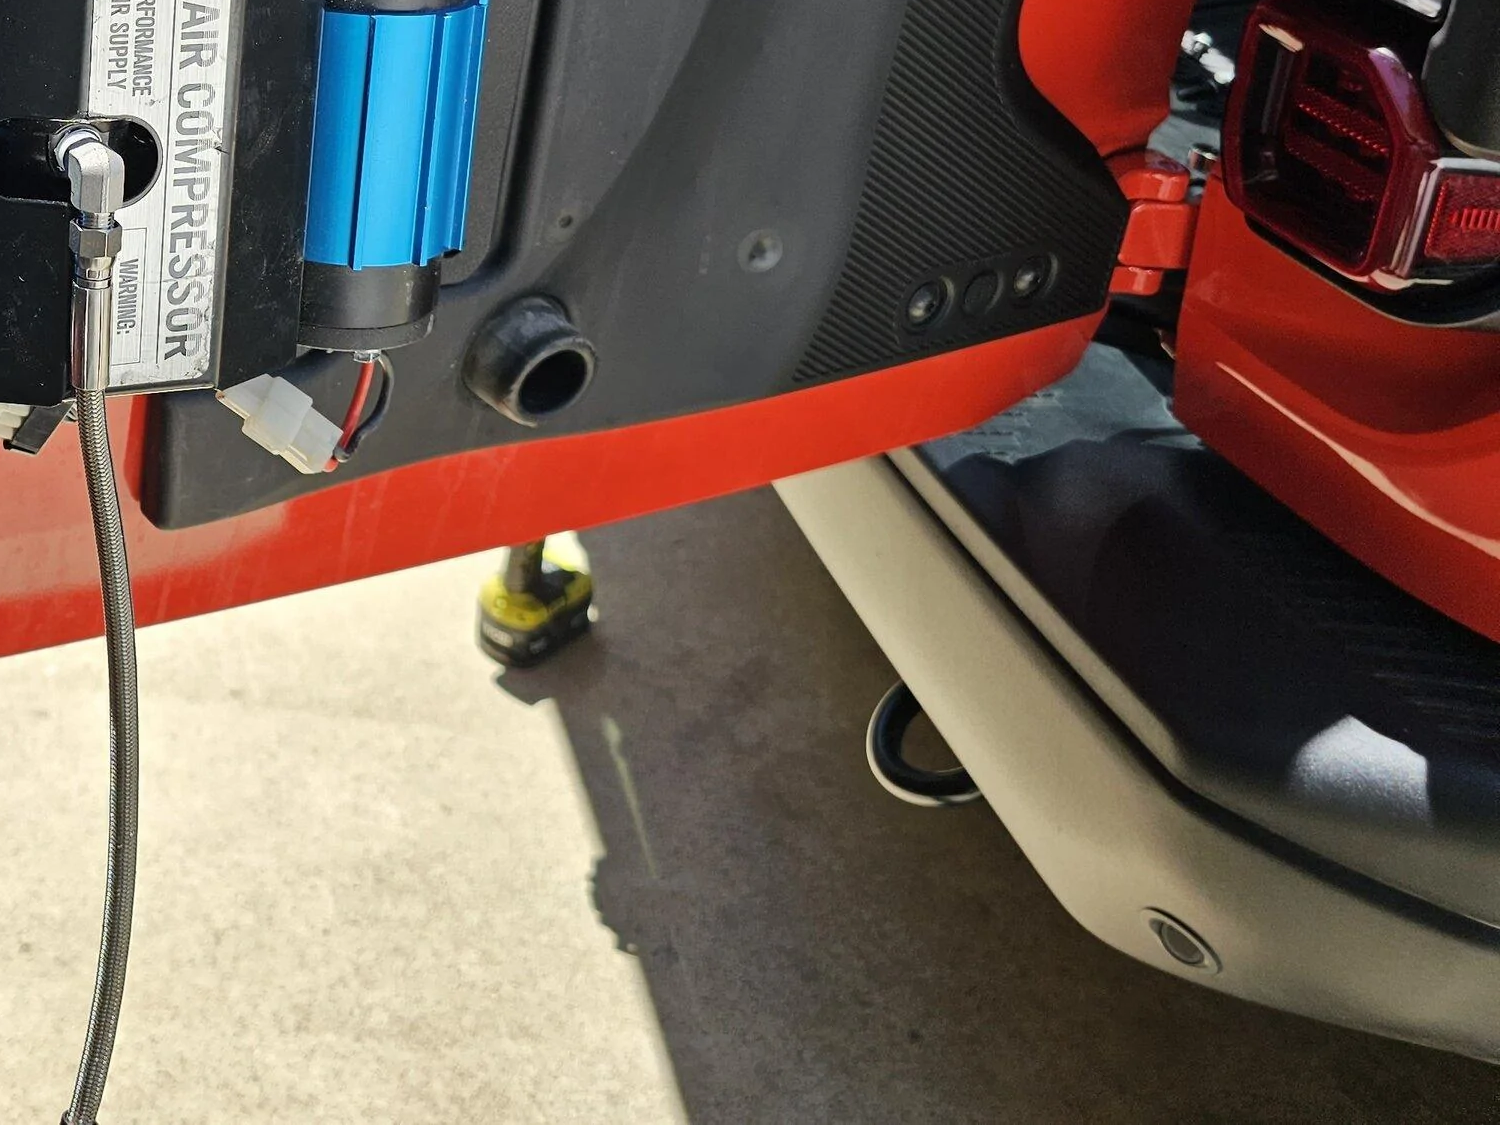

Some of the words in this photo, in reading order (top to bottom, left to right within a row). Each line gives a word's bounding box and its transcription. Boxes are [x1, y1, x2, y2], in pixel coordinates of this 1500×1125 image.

[106, 21, 132, 91] SUPPLY
[178, 0, 221, 71] AIR
[162, 82, 216, 361] COMPRESSOR
[115, 258, 140, 335] WARNING:
